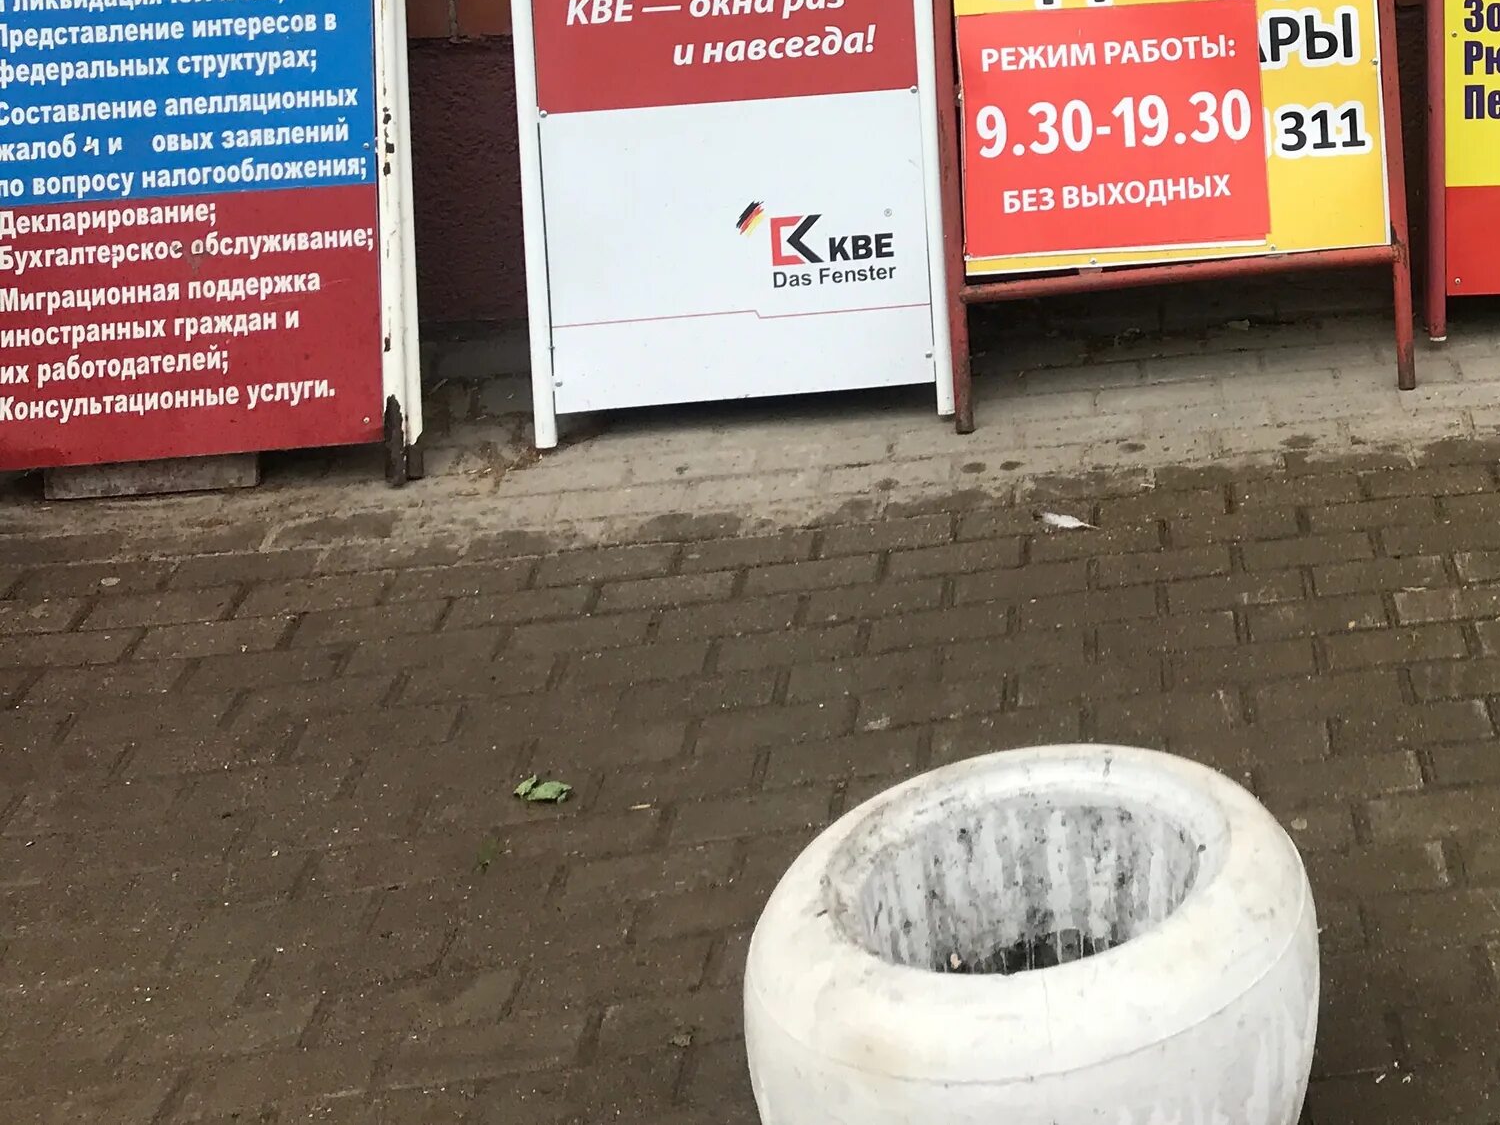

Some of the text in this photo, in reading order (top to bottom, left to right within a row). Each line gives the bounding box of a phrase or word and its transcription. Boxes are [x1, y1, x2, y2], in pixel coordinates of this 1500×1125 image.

[192, 15, 317, 44] интересов
[324, 13, 337, 31] в
[673, 24, 877, 66] и навсегда!
[1259, 12, 1354, 63] РЫ
[0, 46, 317, 89] федеральных структурах;
[981, 35, 1236, 73] РЕЖИМ РАБОТЫ:
[0, 86, 358, 126] Составление апелляционных
[976, 88, 1252, 159] 9.30-19.30
[0, 117, 349, 162] жалоб заявлений
[1280, 108, 1366, 152] 311
[0, 155, 367, 200] по вопросу налогообложения;
[1003, 174, 1231, 214] БЕЗ ВЫХОДНЫХ
[0, 202, 216, 239] Декларирование;
[0, 227, 374, 276] Бухгалтерское обслуживание;
[828, 232, 895, 262] KBE
[1, 271, 320, 315] Миграционная поддержка
[772, 265, 897, 288] Das Fenster
[1, 310, 300, 348] иностранных граждан и
[1, 345, 229, 388] их работодателей;
[0, 378, 336, 425] Консультационные услуги.
